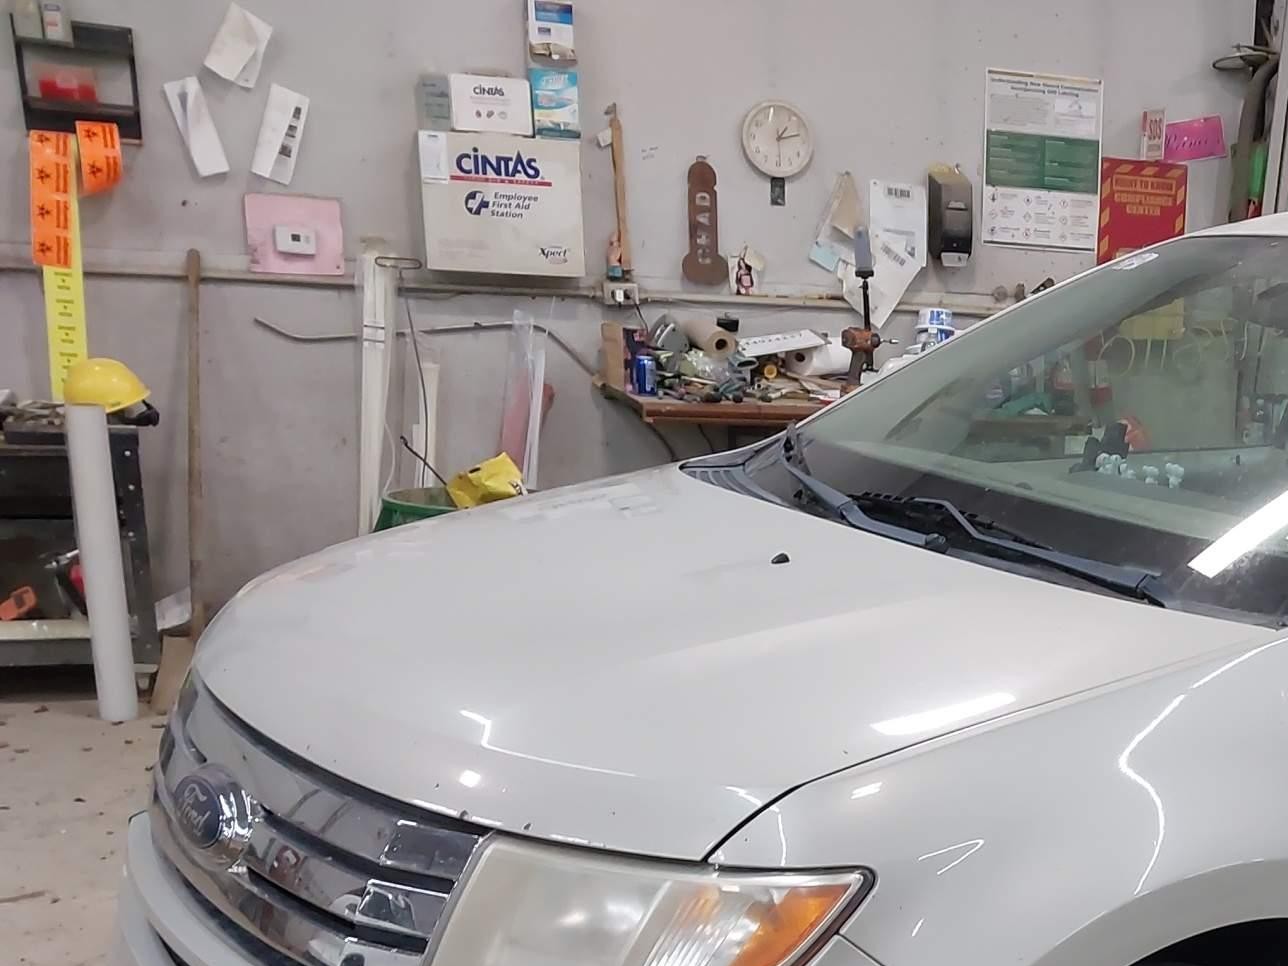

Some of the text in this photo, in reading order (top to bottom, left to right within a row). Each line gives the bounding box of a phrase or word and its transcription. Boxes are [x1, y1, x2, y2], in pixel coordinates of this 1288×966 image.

[494, 191, 539, 202] Employee
[492, 201, 531, 210] First Aid
[490, 210, 523, 219] Station
